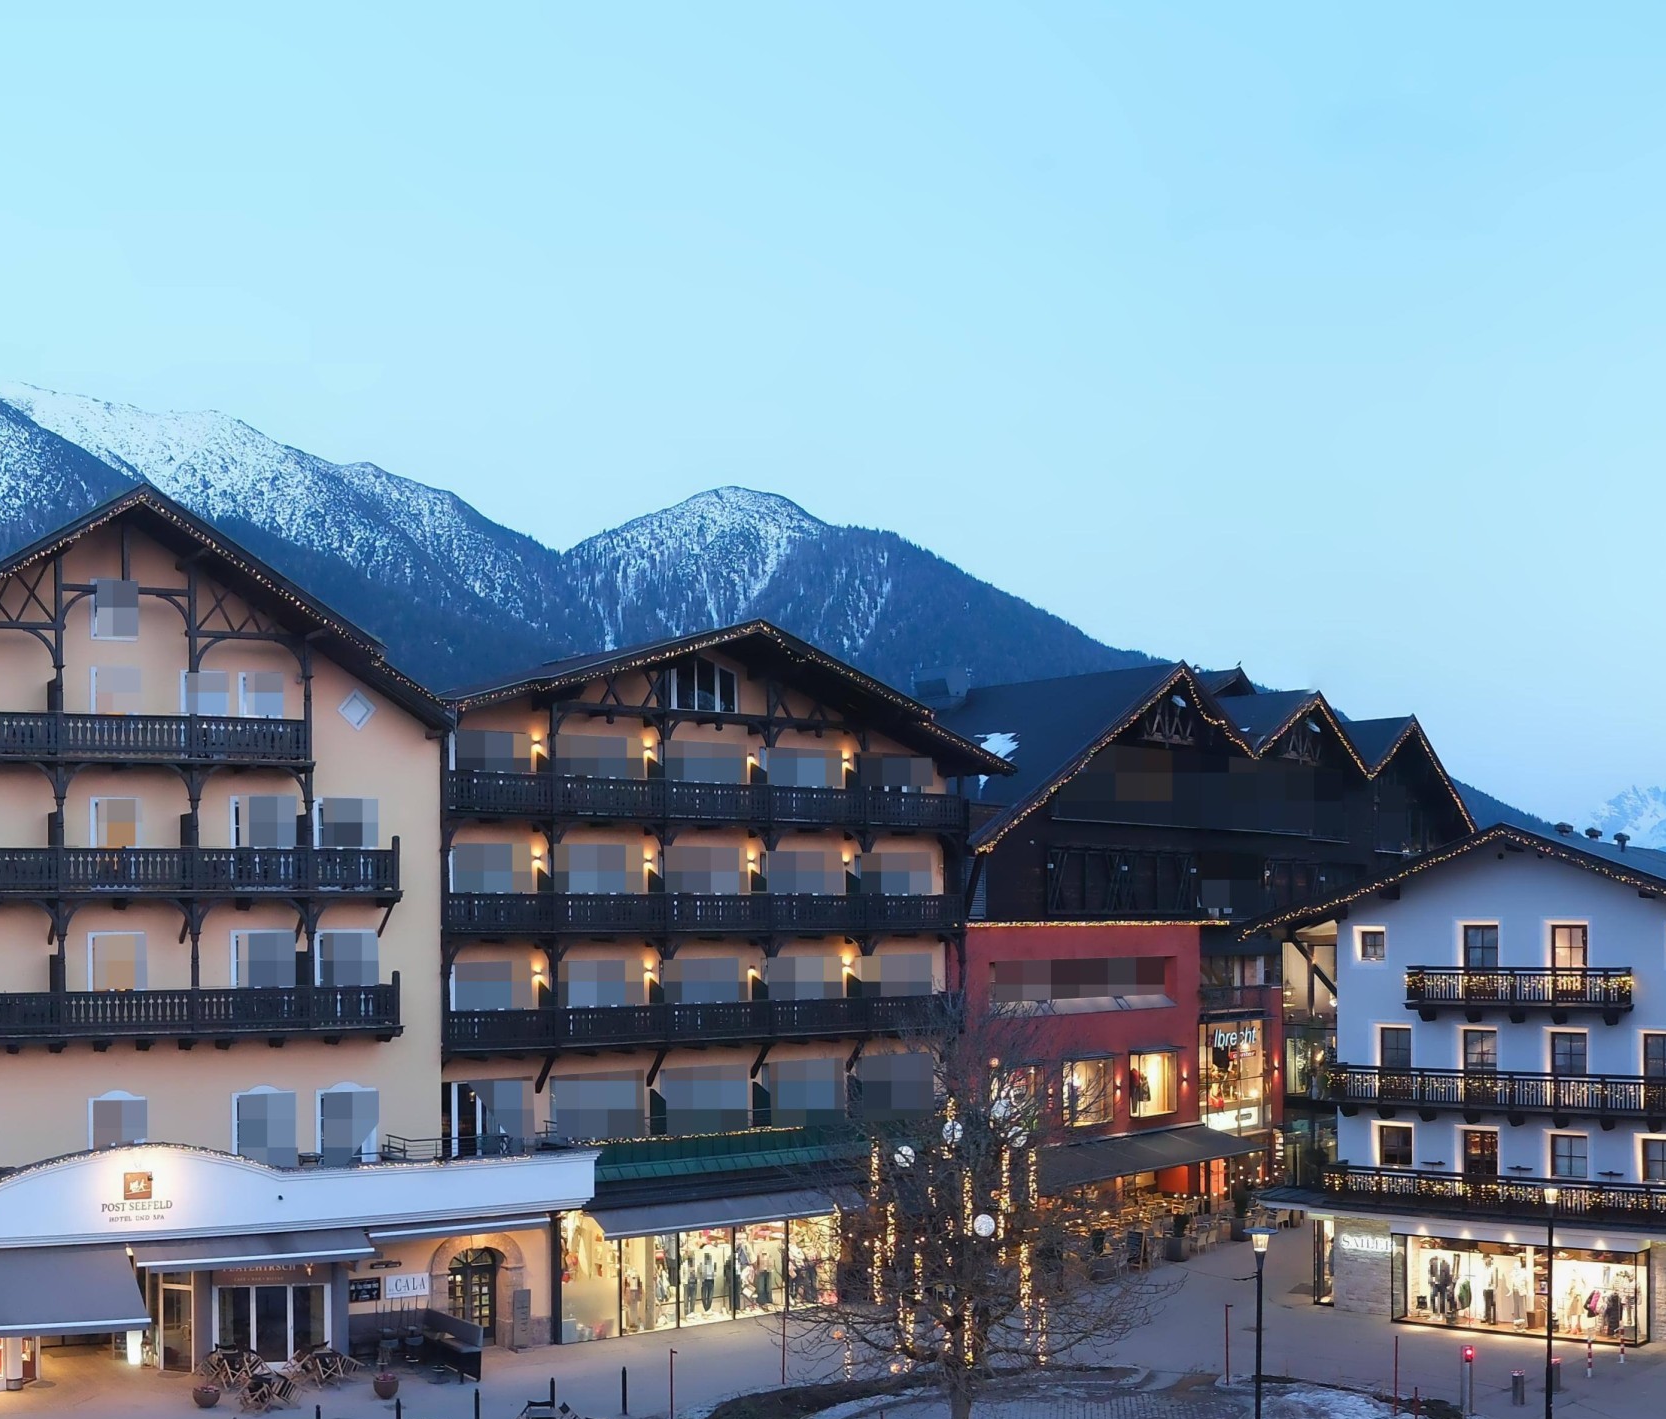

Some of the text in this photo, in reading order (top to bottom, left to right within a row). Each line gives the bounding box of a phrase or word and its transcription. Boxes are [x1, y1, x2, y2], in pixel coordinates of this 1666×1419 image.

[101, 1200, 173, 1212] POST SEEFELD
[395, 1277, 425, 1292] CALA
